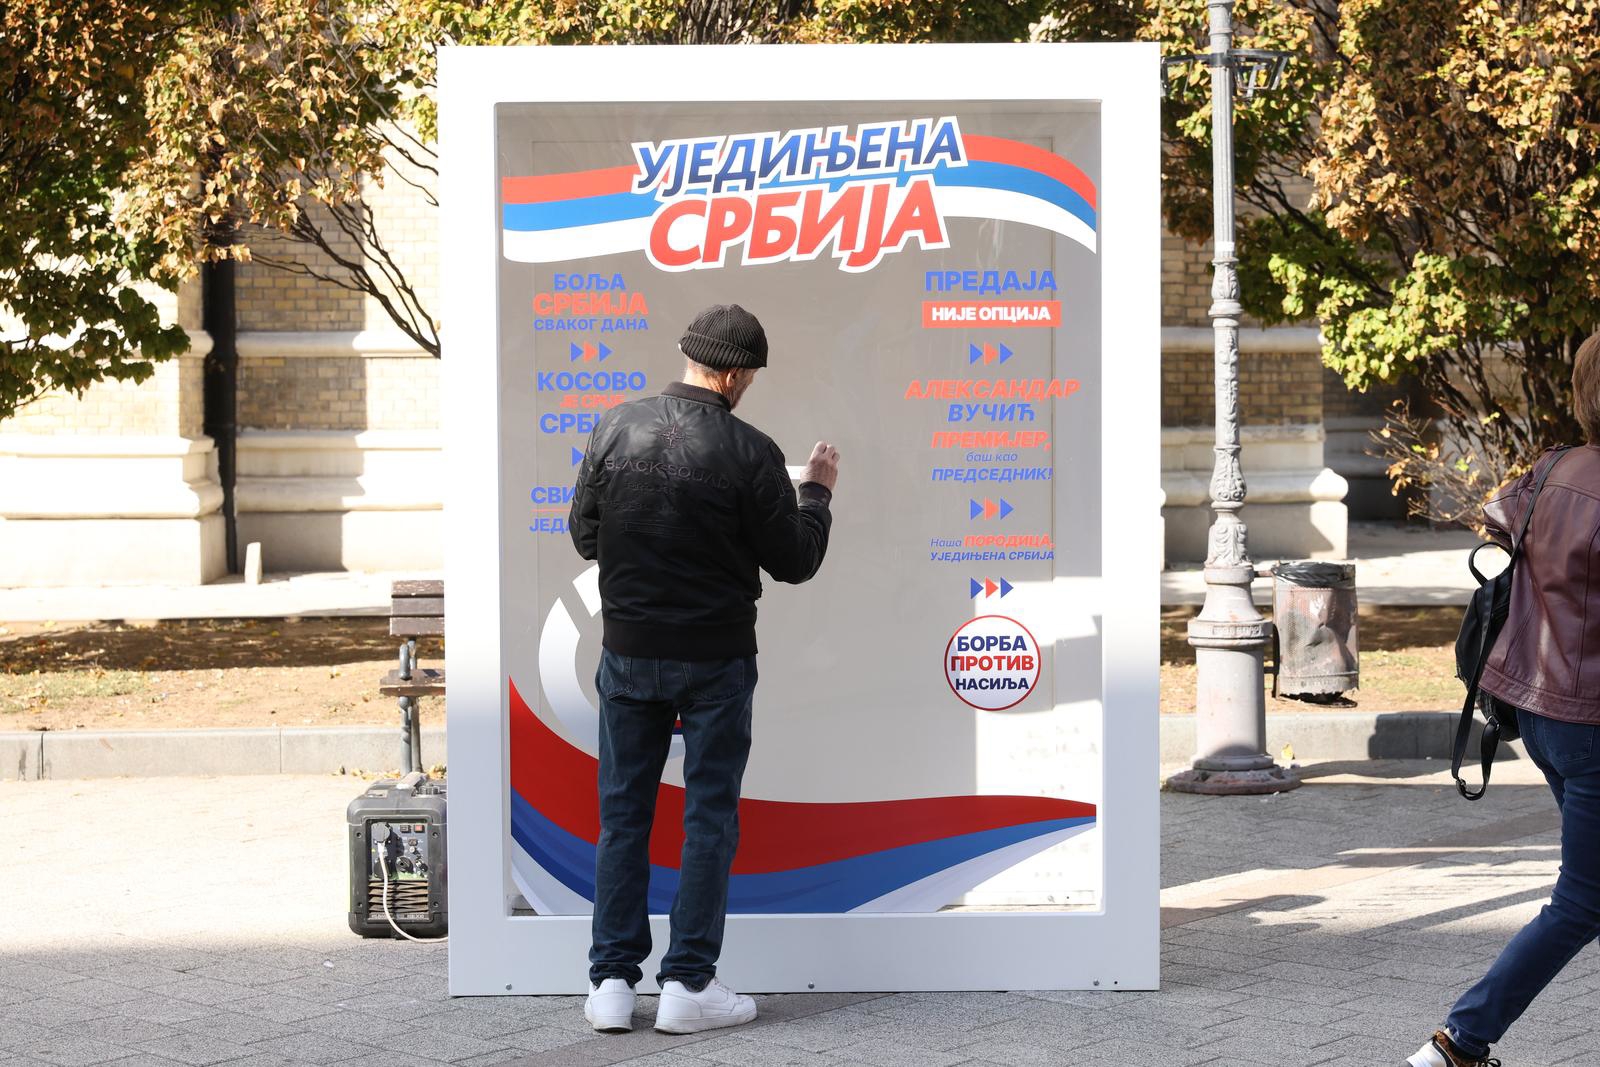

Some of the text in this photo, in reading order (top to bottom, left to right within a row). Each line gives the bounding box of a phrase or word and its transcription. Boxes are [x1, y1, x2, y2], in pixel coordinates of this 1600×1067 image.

[636, 121, 962, 196] УЈЕДИЊЕНА
[650, 179, 944, 268] СРБИЈА
[553, 273, 625, 291] БОЉА
[925, 270, 1058, 295] ПРЕДАЈА
[533, 291, 649, 317] СРБИЈА
[932, 307, 1051, 323] НИЈЕ ОПЦИЈА
[533, 318, 648, 333] СВАКОГ ДАНА
[537, 372, 646, 392] КОСОВО
[905, 379, 1080, 402] АЛЕКСАНДАР
[947, 403, 1035, 422] ВУЧИЋ
[931, 431, 1051, 451] ПРЕМИЈЕР,
[966, 451, 1017, 463] баш као
[932, 467, 1053, 484] ПРЕДСЕДНИК!
[931, 533, 1055, 548] Наша ПОРОДИЦА,
[930, 551, 1055, 562] УЈЕДИЊЕНА СРБИЈА
[957, 636, 1027, 651] БОРБА
[951, 655, 1034, 671] ПРОТИВ
[955, 678, 1029, 691] НАСИЉА
